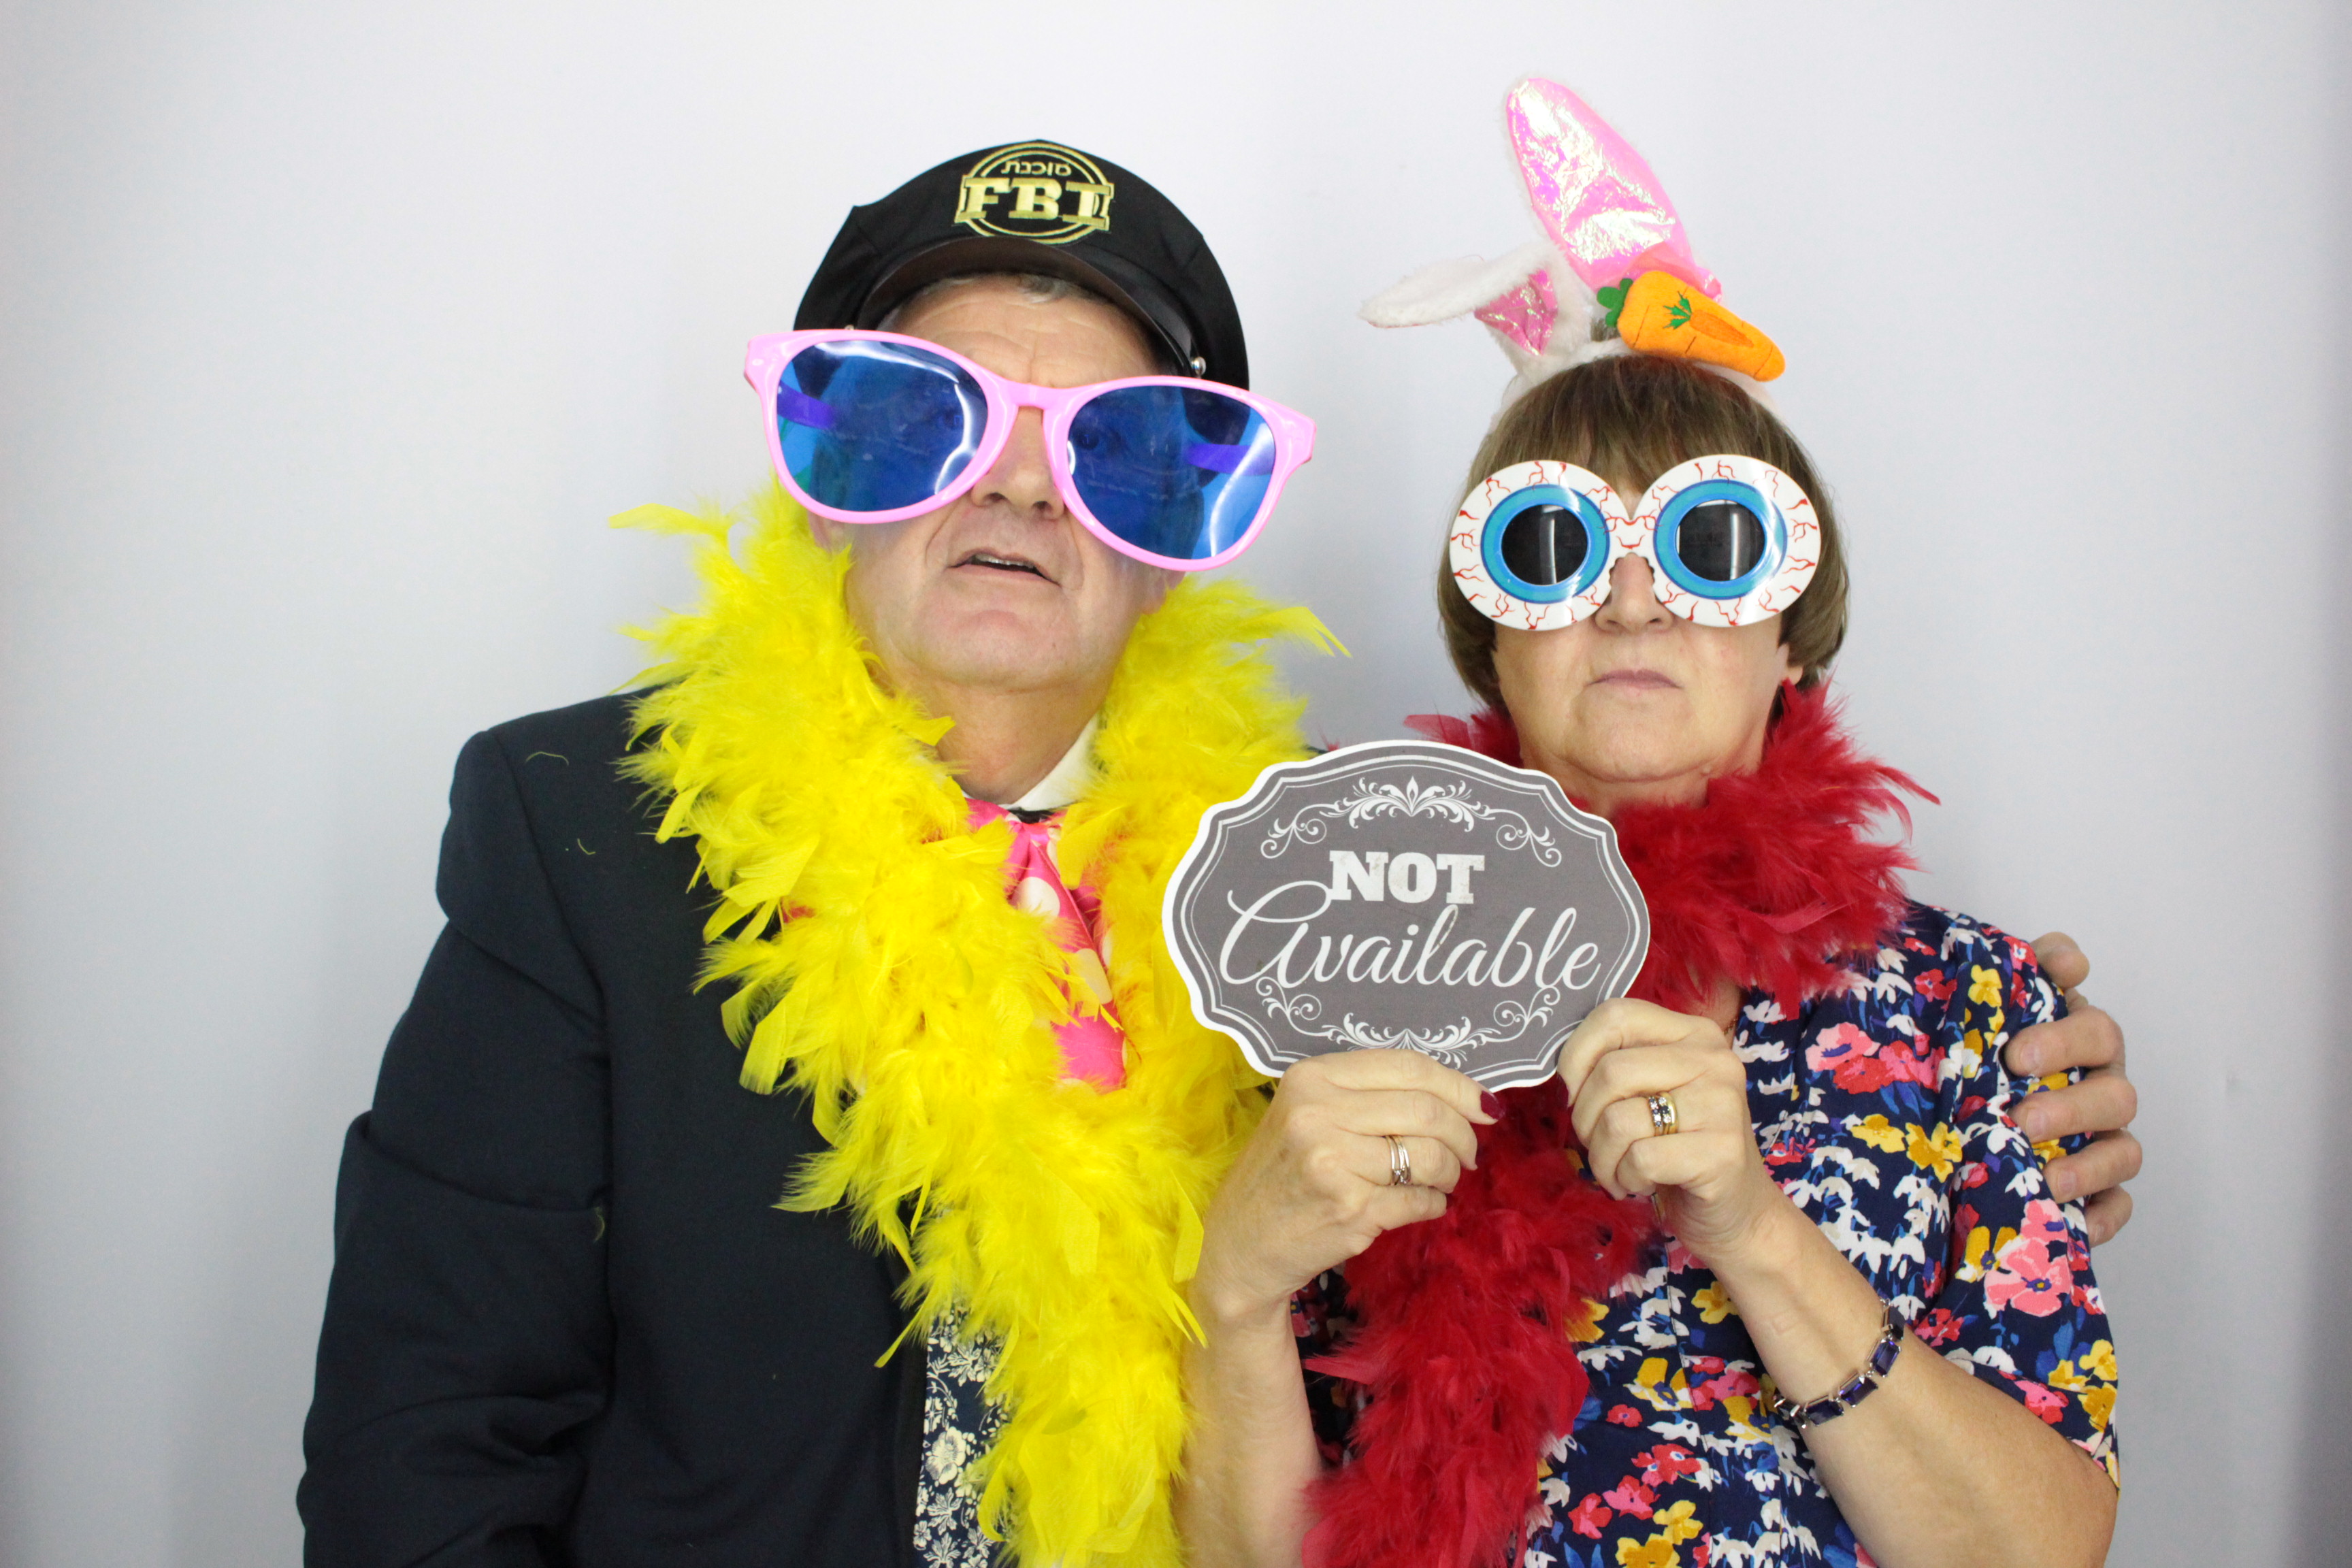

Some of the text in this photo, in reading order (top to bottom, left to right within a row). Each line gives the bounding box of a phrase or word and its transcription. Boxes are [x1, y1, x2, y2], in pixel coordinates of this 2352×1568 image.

[1000, 160, 1072, 176] סוכנת
[957, 176, 1111, 229] FBI
[1328, 850, 1485, 904] NOT
[1219, 880, 1601, 990] Available
